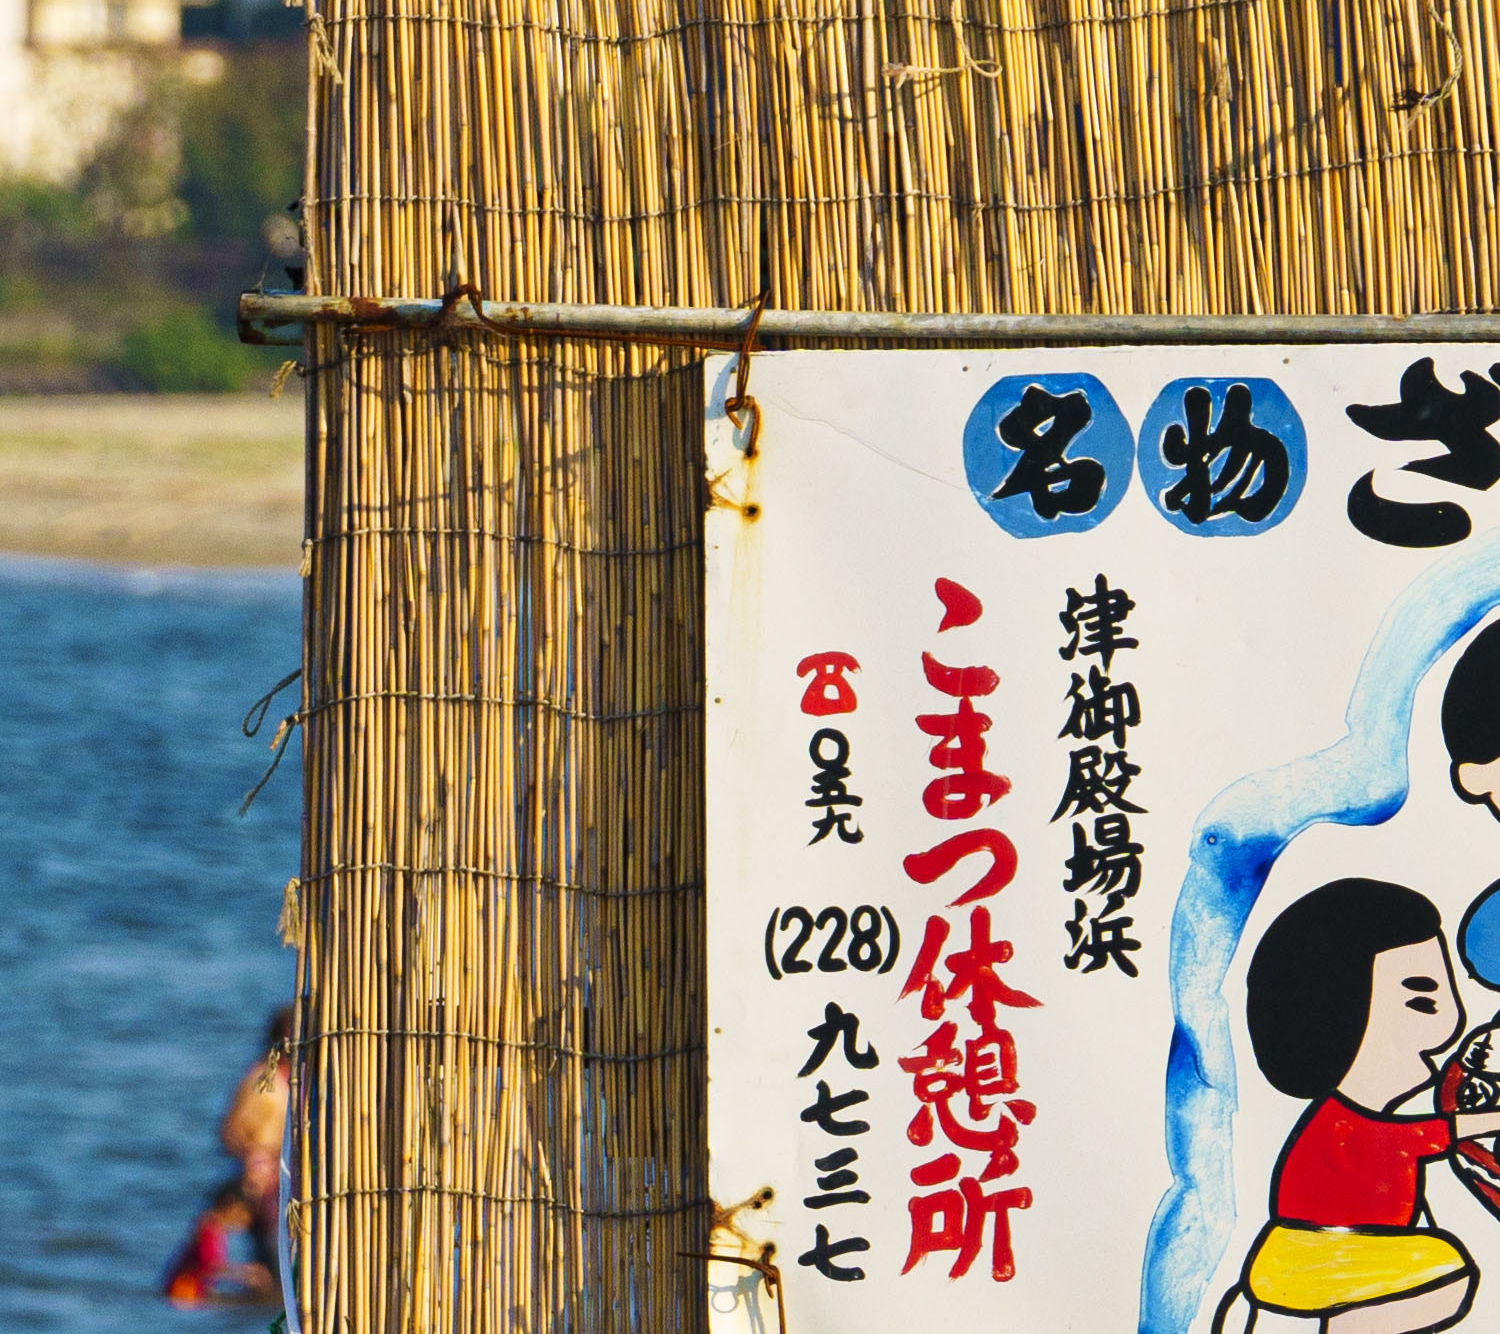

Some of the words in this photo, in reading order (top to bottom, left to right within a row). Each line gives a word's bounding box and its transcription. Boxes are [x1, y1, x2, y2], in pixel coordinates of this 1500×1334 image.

[992, 385, 1289, 524] 名物
[899, 578, 1042, 1281] こまつ休憩所
[1051, 574, 1147, 977] 津御殿場浜
[798, 1002, 878, 1281] 九七三七
